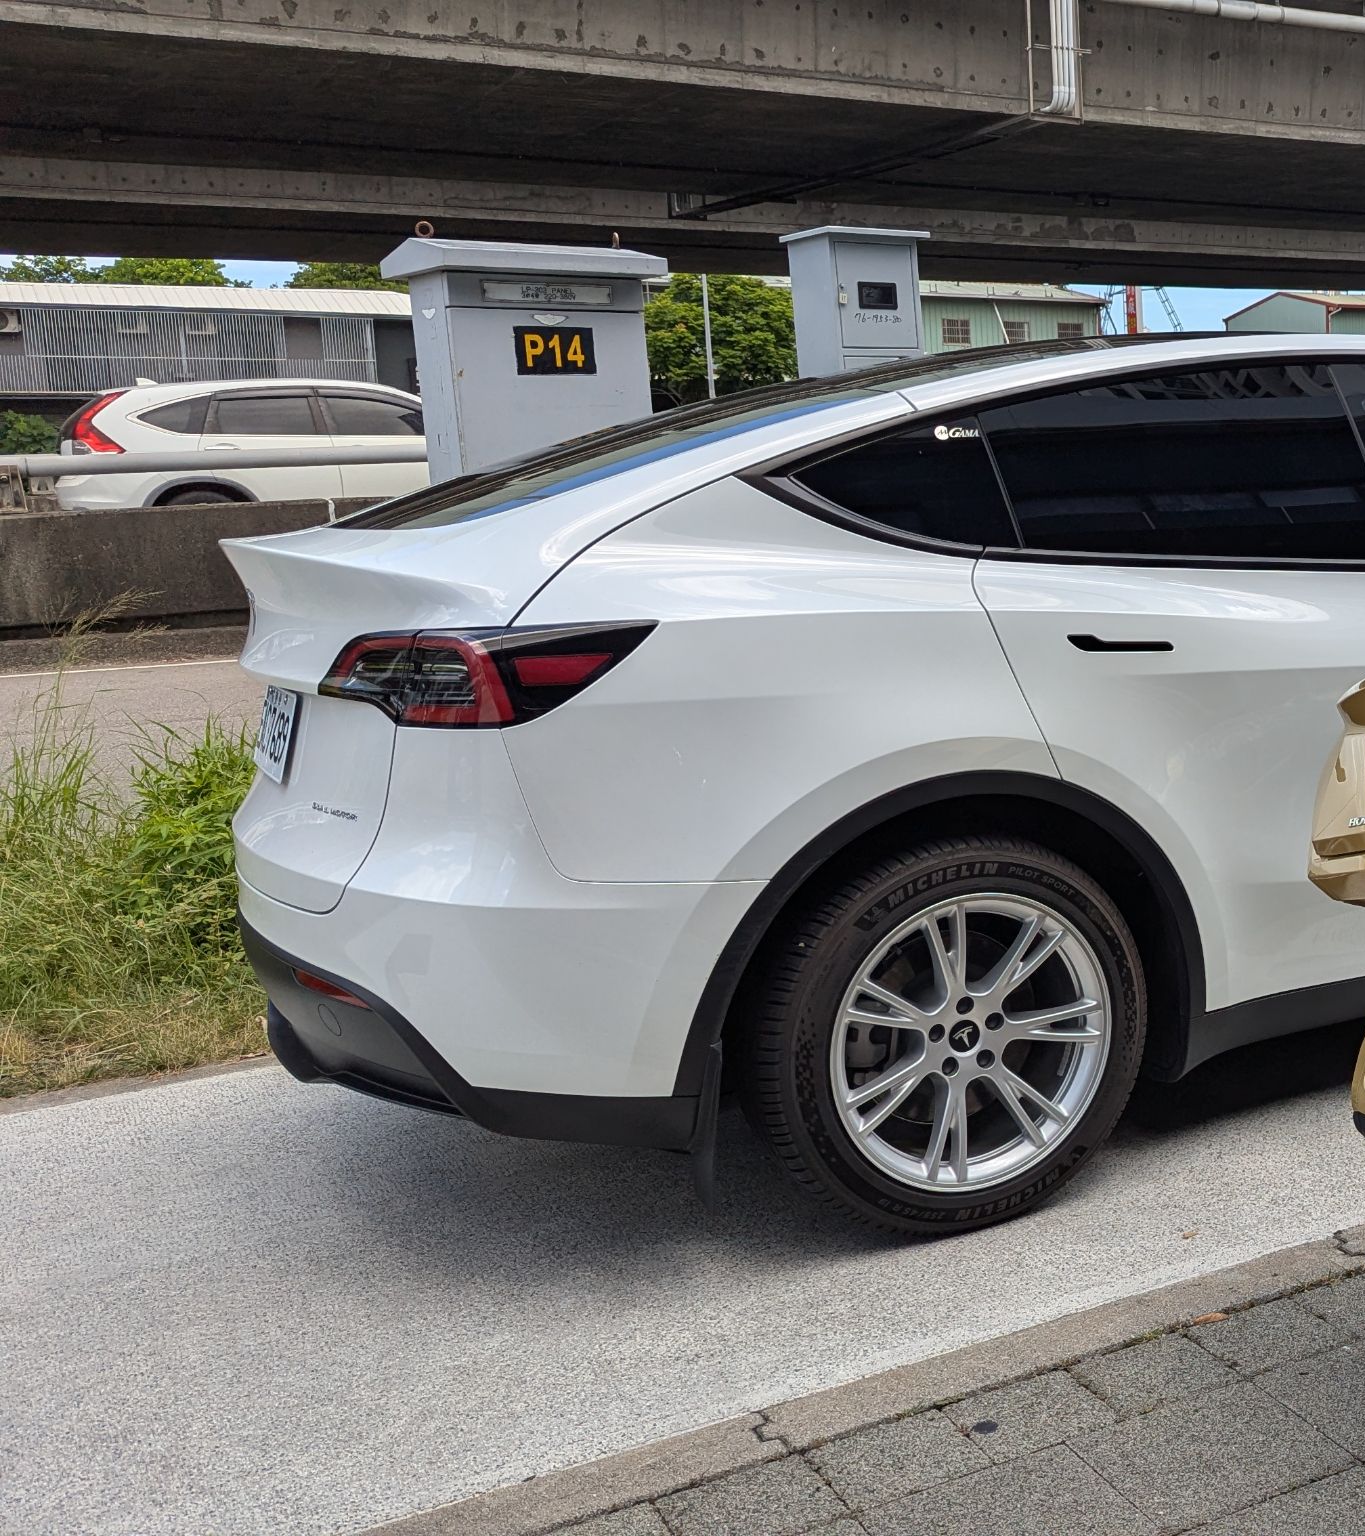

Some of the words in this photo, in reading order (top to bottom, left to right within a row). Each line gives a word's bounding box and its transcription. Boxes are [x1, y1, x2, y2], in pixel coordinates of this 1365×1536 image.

[524, 334, 585, 368] P14
[889, 862, 999, 909] MICHELIN
[1008, 865, 1039, 880] PILOT
[1041, 874, 1075, 897] SPORT
[954, 1167, 1061, 1221] MICHELIN
